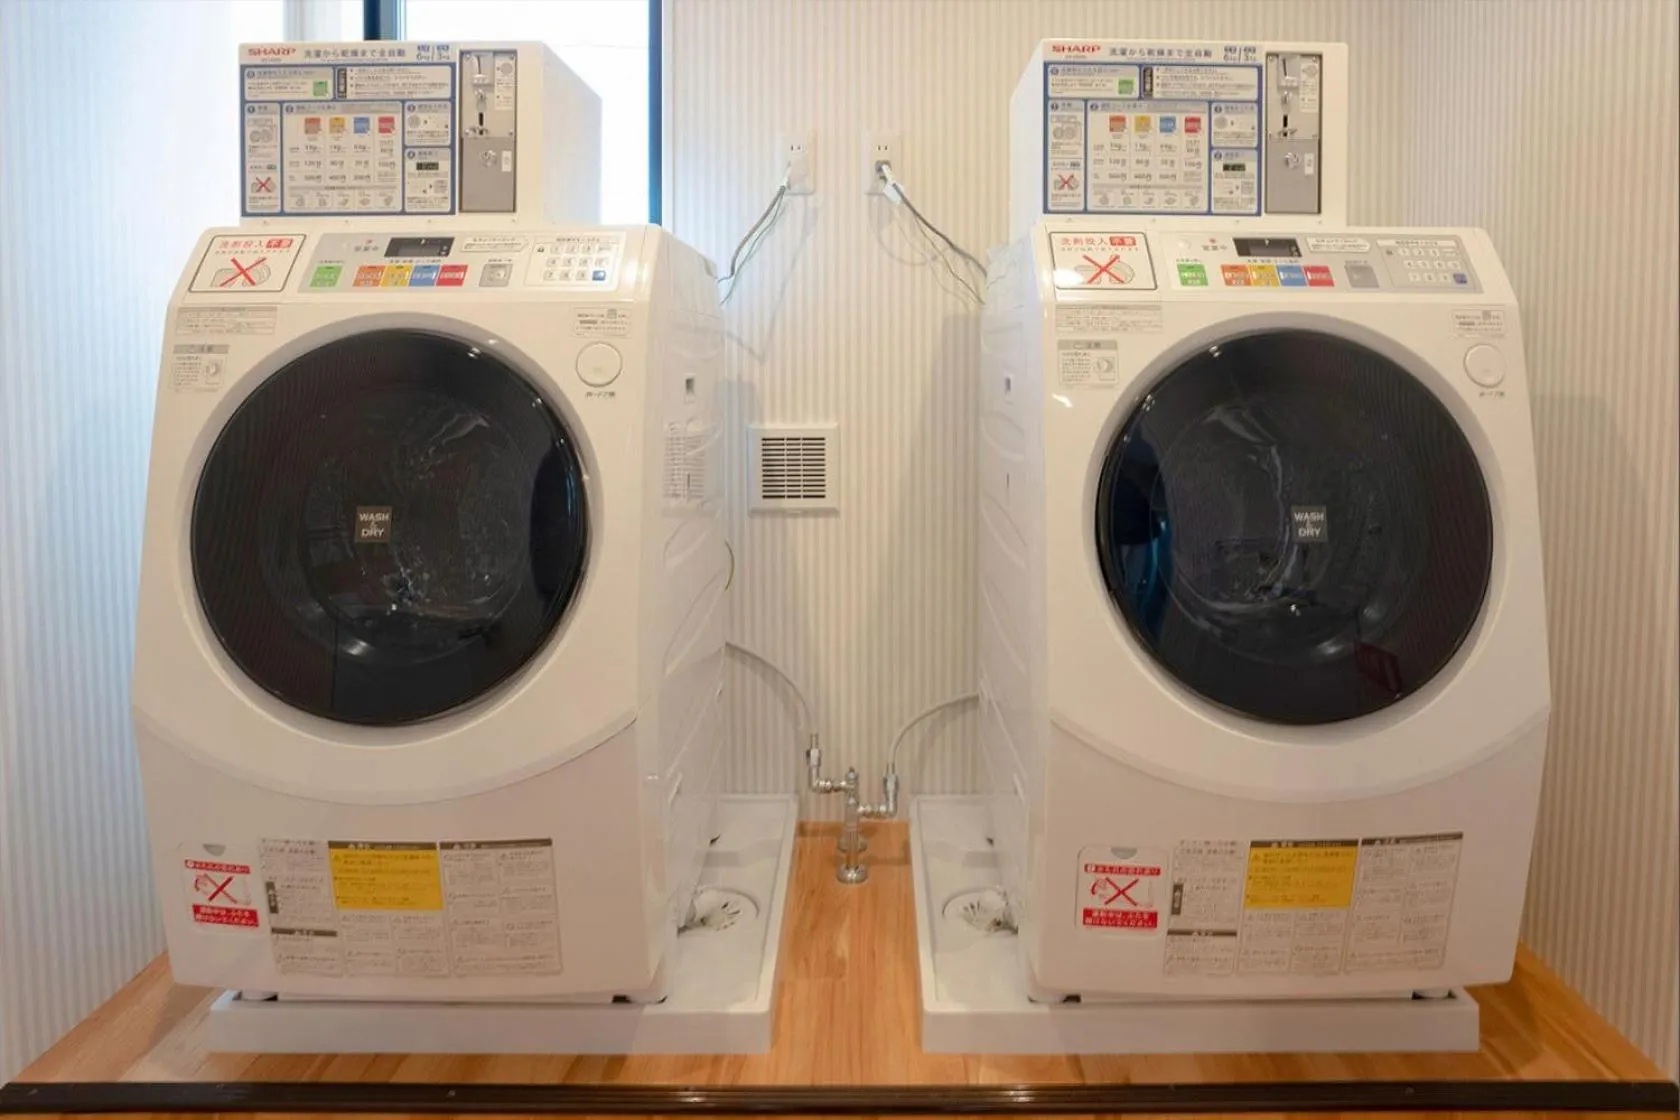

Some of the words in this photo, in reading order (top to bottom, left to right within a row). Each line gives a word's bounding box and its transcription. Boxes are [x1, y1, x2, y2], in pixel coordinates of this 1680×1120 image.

[248, 48, 297, 56] SHARP
[1051, 45, 1101, 53] SHARP
[359, 512, 389, 521] WASH
[1294, 512, 1324, 521] WASH
[361, 528, 384, 537] DRY
[1298, 528, 1321, 537] DRY
